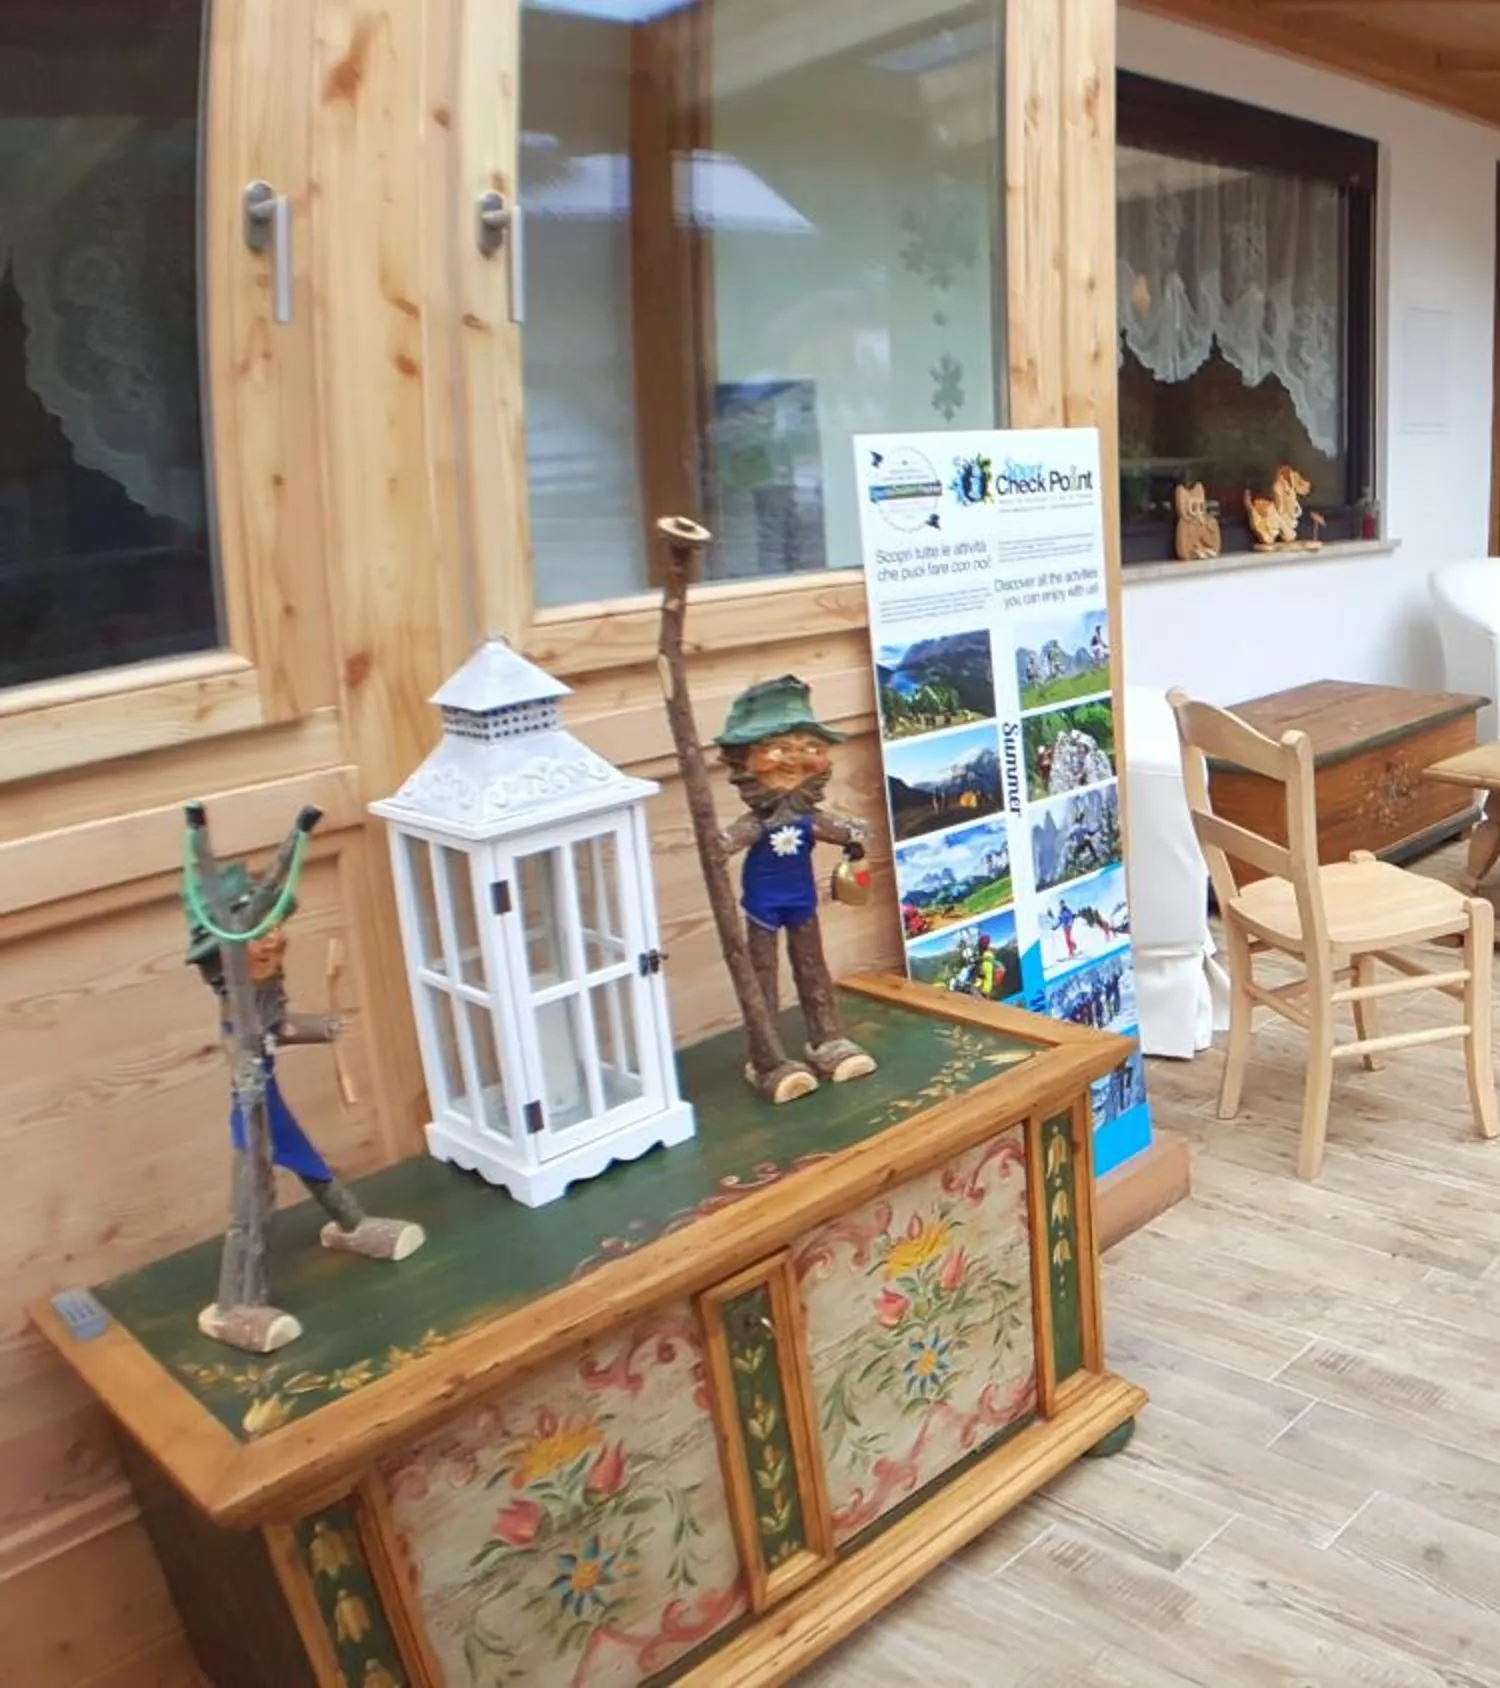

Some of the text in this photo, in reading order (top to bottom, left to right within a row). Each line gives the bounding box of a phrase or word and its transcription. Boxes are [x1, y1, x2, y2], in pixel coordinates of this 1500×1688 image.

[995, 464, 1093, 496] Check Point
[877, 567, 899, 582] che
[993, 577, 1036, 592] Discover
[1002, 721, 1022, 818] Summer
